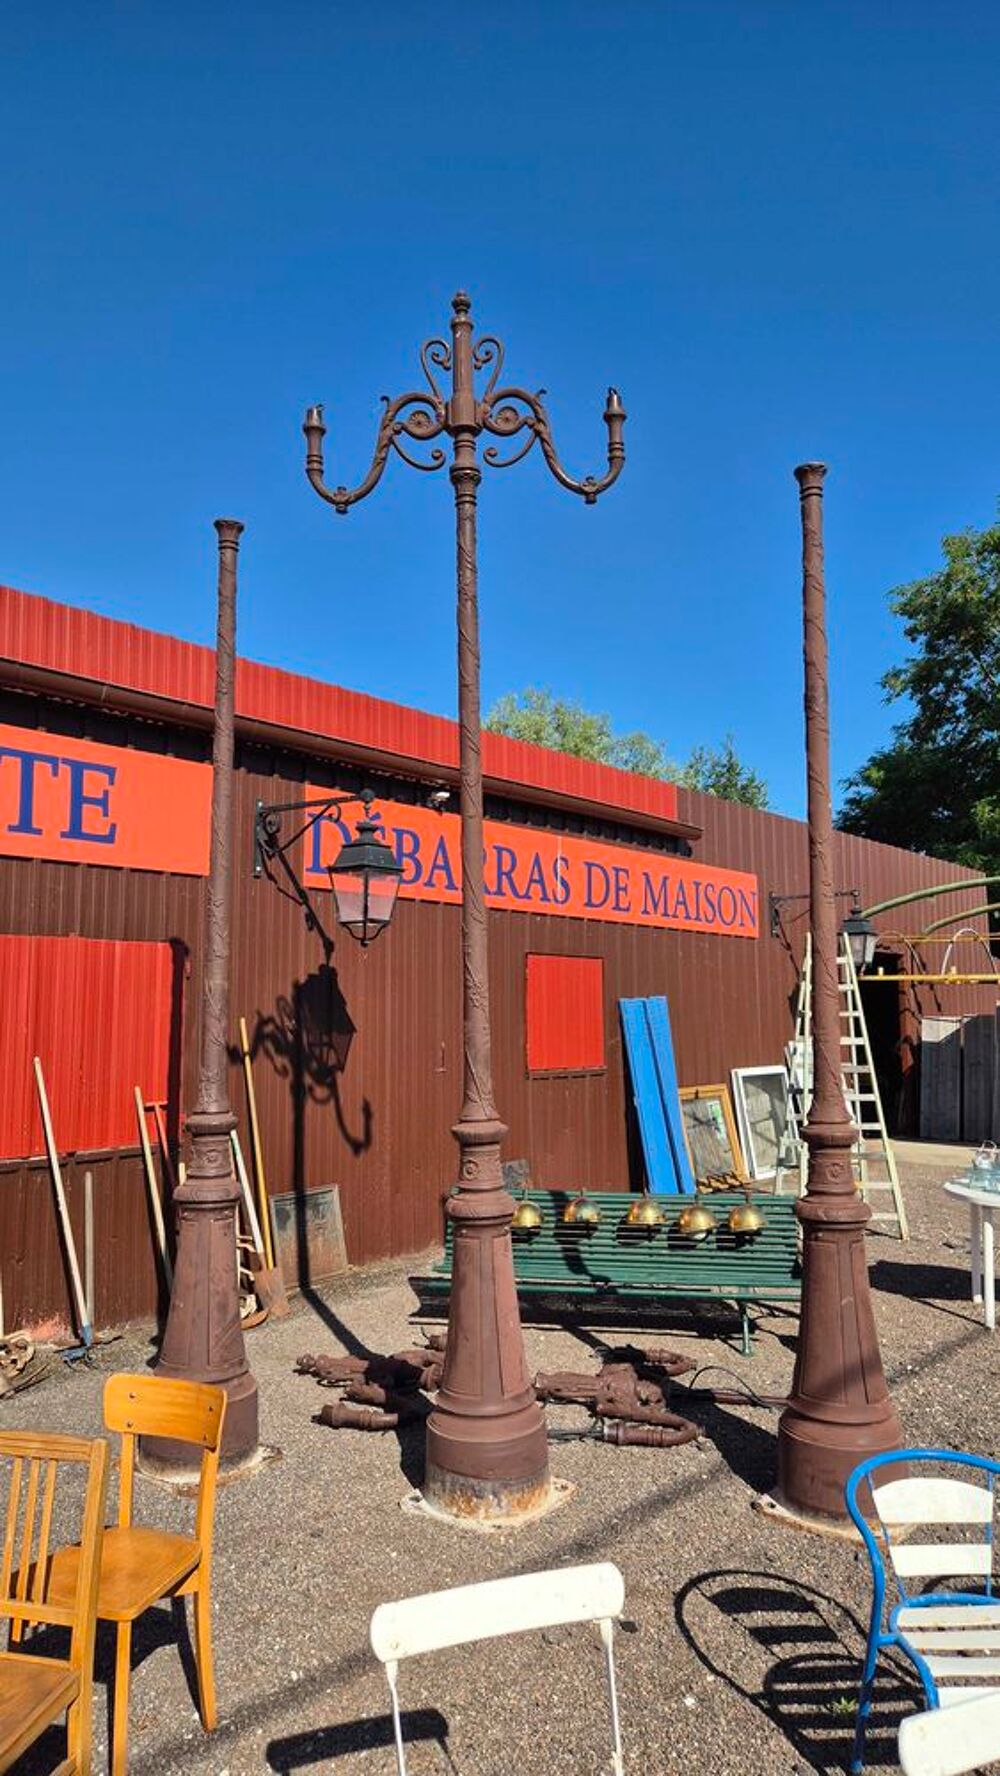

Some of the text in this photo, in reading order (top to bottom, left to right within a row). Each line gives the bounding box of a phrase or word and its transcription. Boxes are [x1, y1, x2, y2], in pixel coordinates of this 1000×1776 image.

[306, 812, 757, 927] DBARAS DE MAISON
